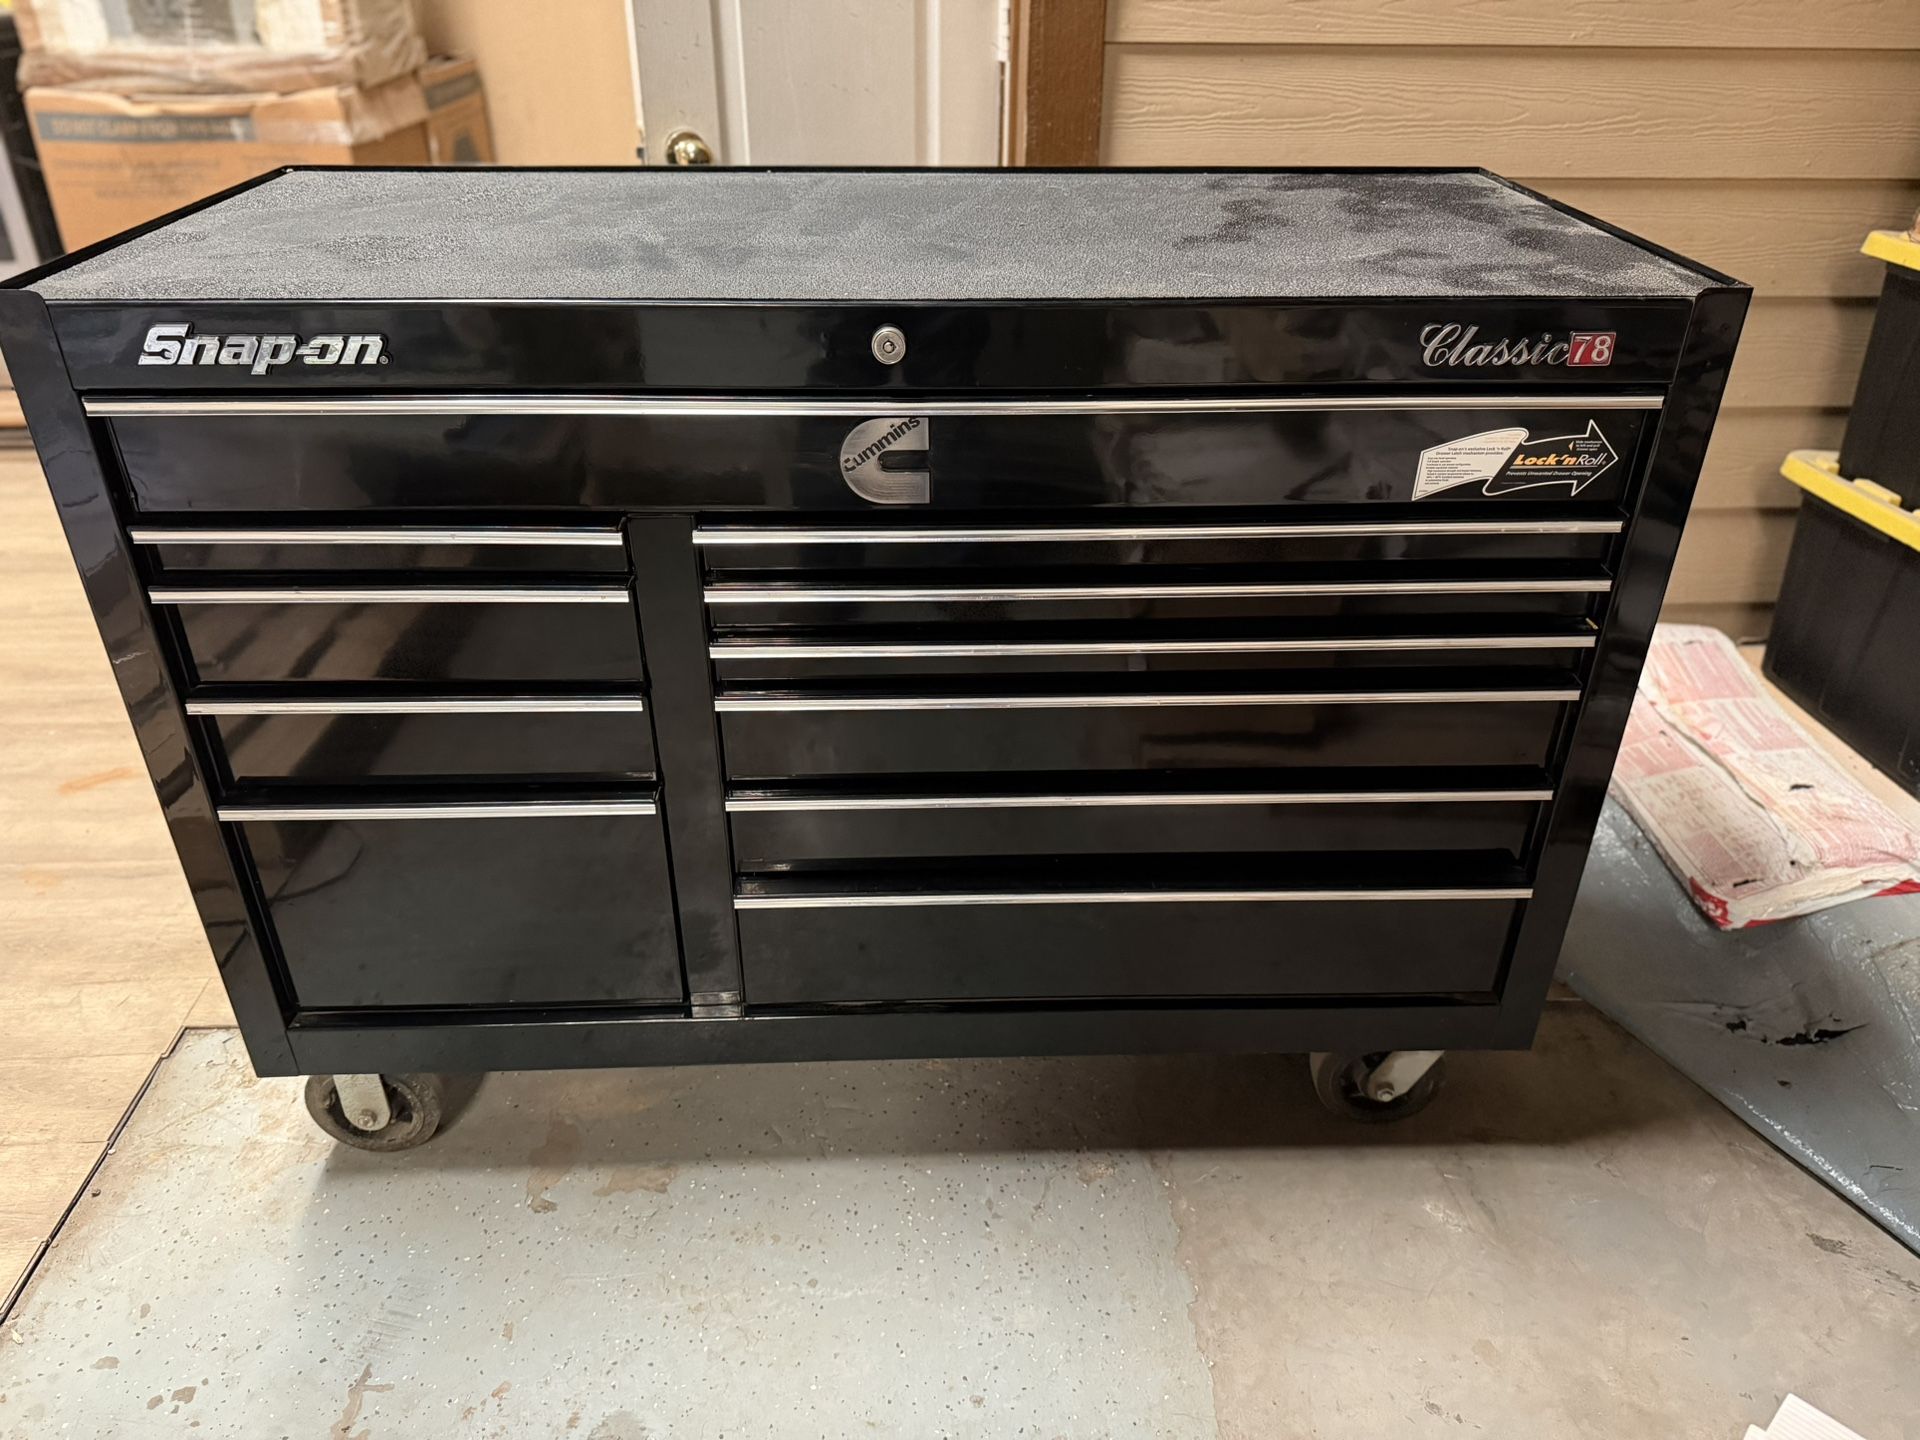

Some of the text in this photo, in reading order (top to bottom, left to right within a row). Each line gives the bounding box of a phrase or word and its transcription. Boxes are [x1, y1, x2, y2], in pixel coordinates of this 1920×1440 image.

[138, 322, 384, 376] Snap-on
[1419, 321, 1612, 367] Classic 78
[843, 416, 921, 473] Cummins
